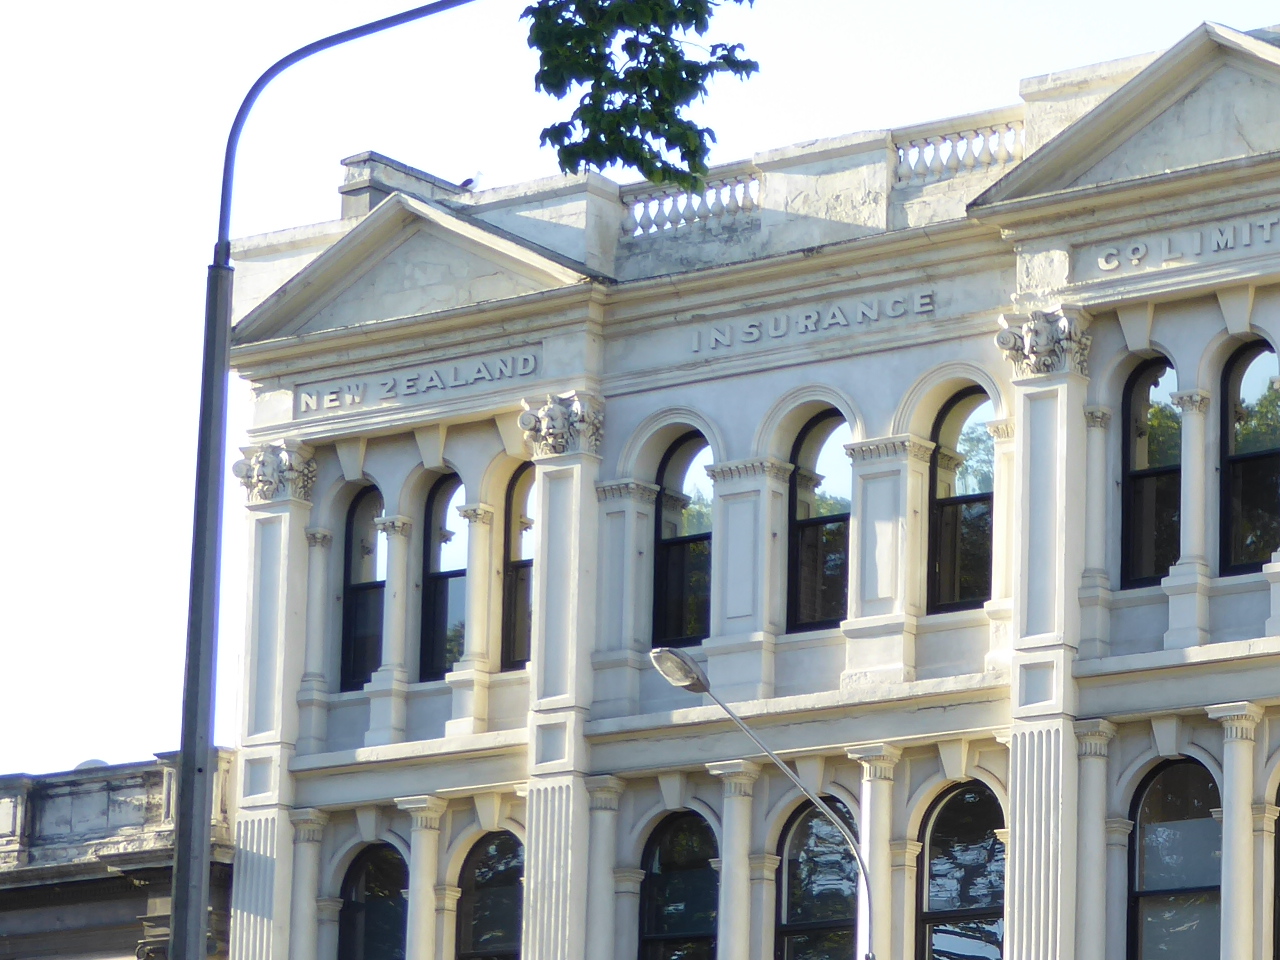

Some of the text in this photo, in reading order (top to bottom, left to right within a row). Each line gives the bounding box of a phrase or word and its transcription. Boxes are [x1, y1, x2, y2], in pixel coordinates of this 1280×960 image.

[692, 290, 935, 353] INSURANCE
[300, 353, 538, 413] NEW ZEALAND
